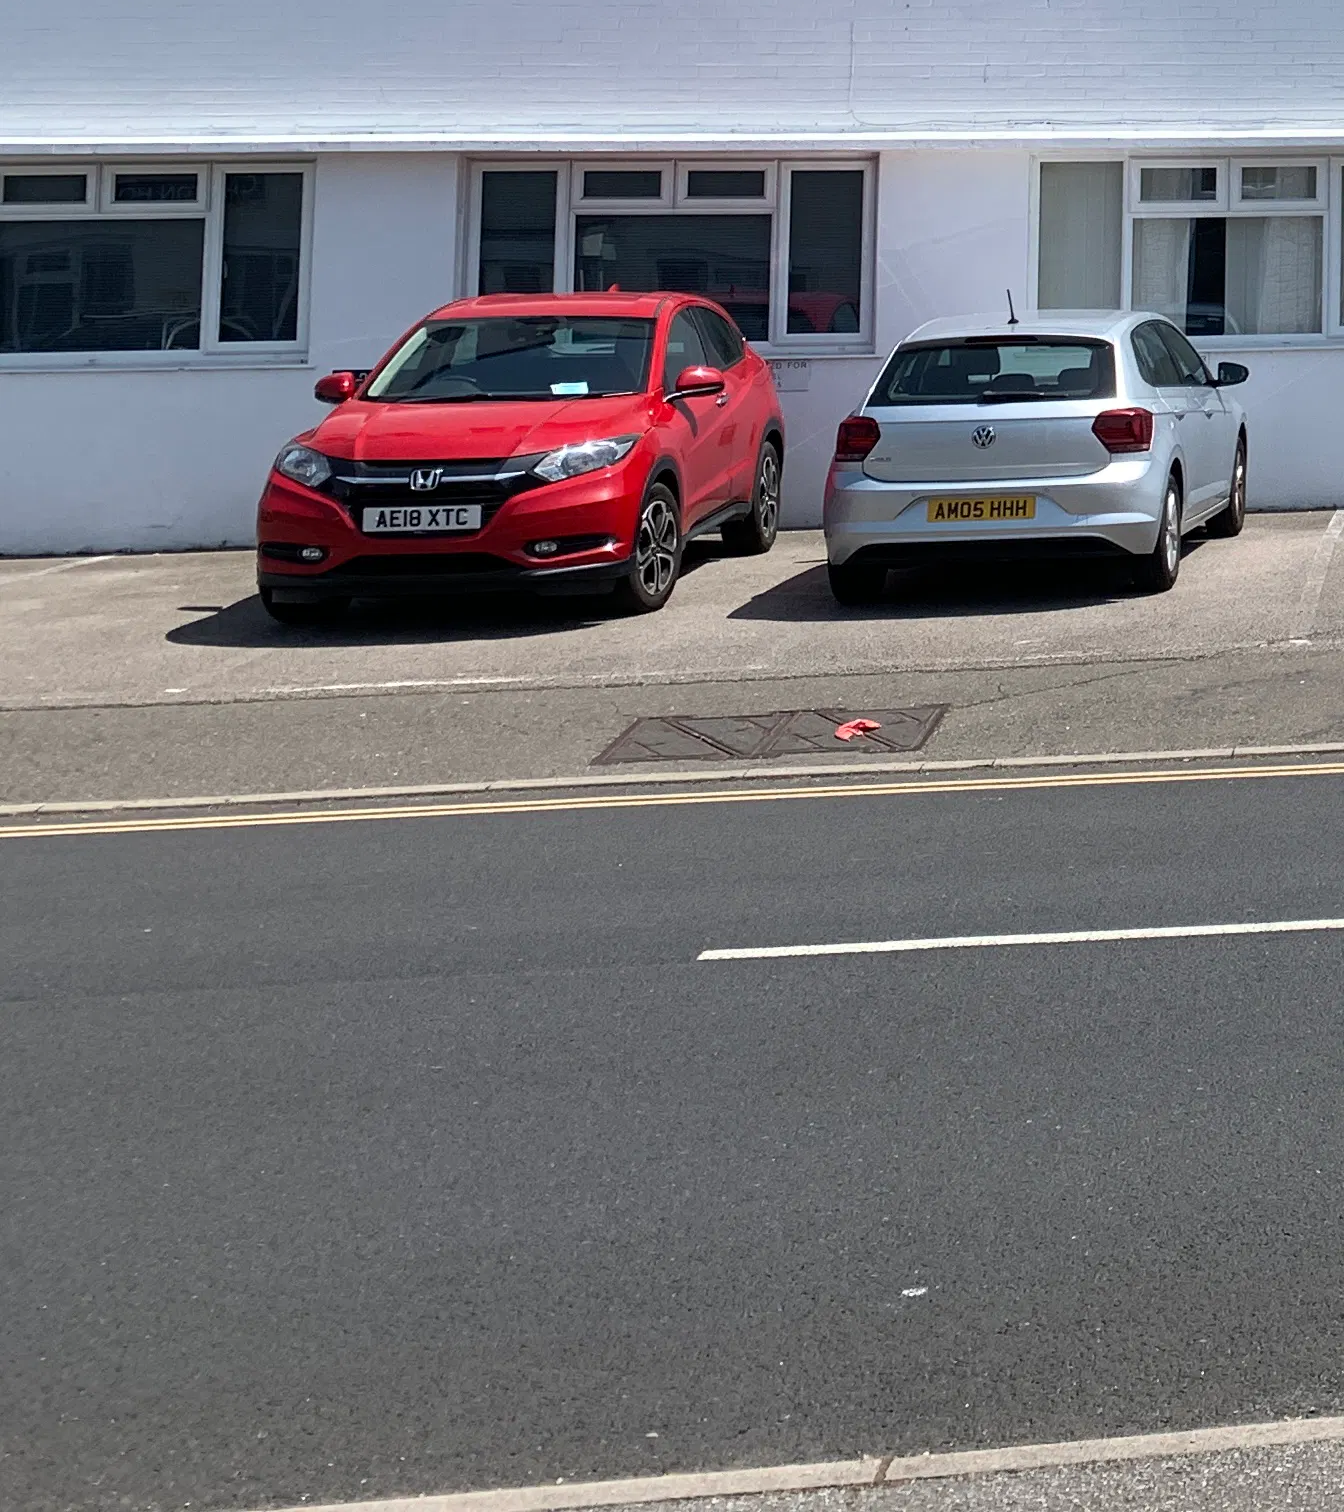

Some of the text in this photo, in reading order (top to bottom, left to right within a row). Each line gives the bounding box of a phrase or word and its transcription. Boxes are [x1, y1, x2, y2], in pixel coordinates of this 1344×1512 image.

[787, 361, 808, 369] FOR
[376, 508, 469, 528] AE18 XTC
[935, 499, 1027, 520] AM05 HHH
